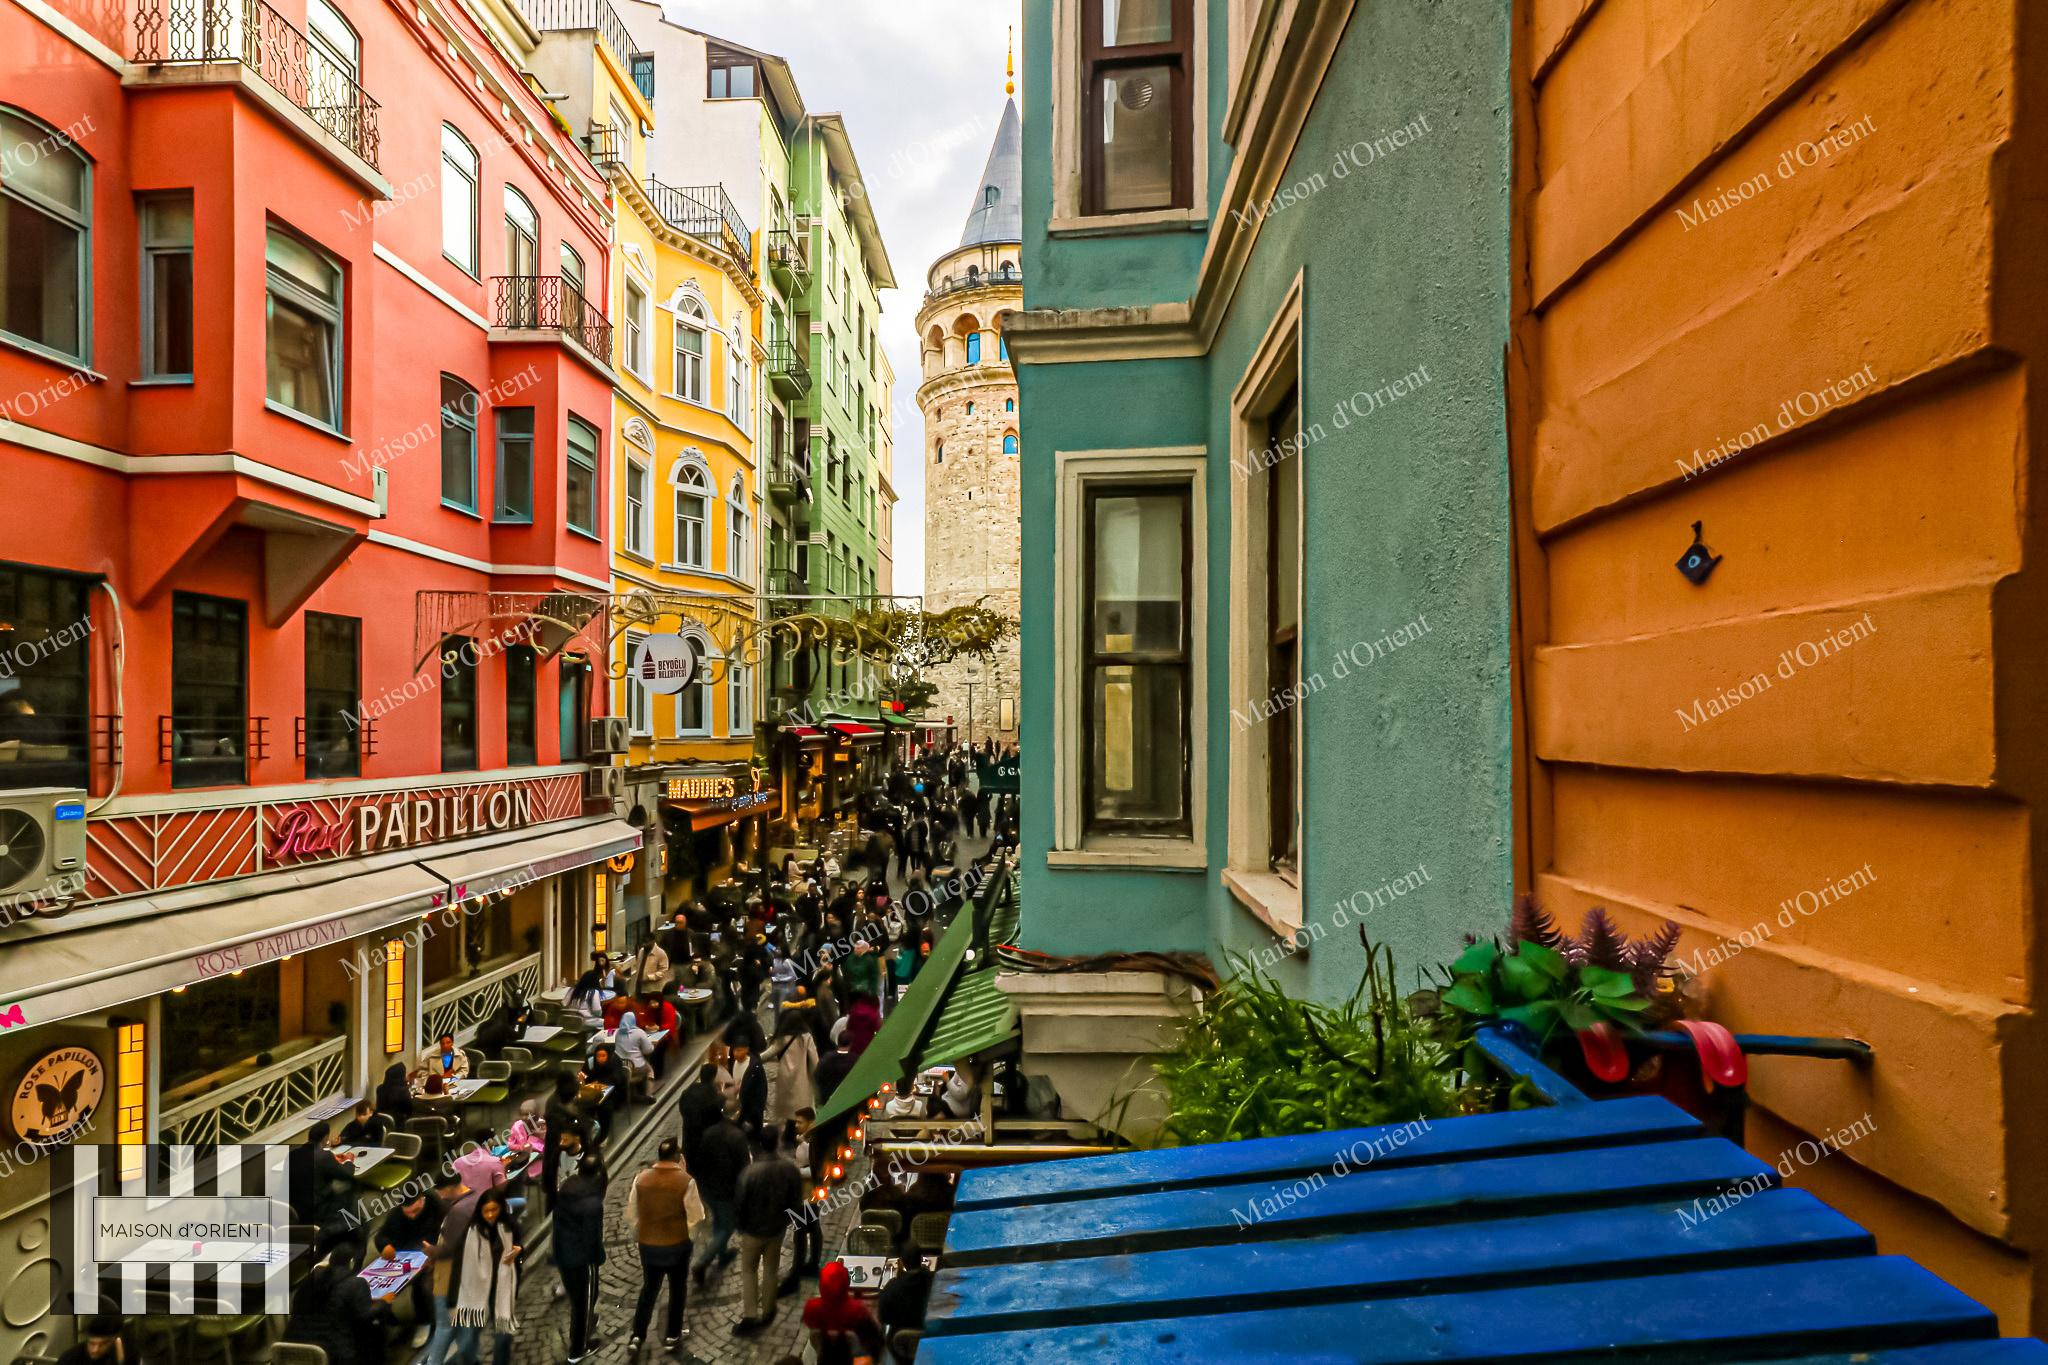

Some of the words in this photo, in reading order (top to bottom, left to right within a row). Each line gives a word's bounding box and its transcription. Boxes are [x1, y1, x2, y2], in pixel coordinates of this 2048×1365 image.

[658, 658, 686, 671] BEYOĞLU
[668, 777, 735, 799] MADDIE'S
[266, 806, 344, 861] Rose
[359, 788, 533, 852] PAPILLON
[194, 946, 246, 977] ROSE
[255, 920, 348, 961] PAPILLONYA
[19, 1066, 46, 1099] ROSE
[47, 1051, 99, 1076] PAPILLON
